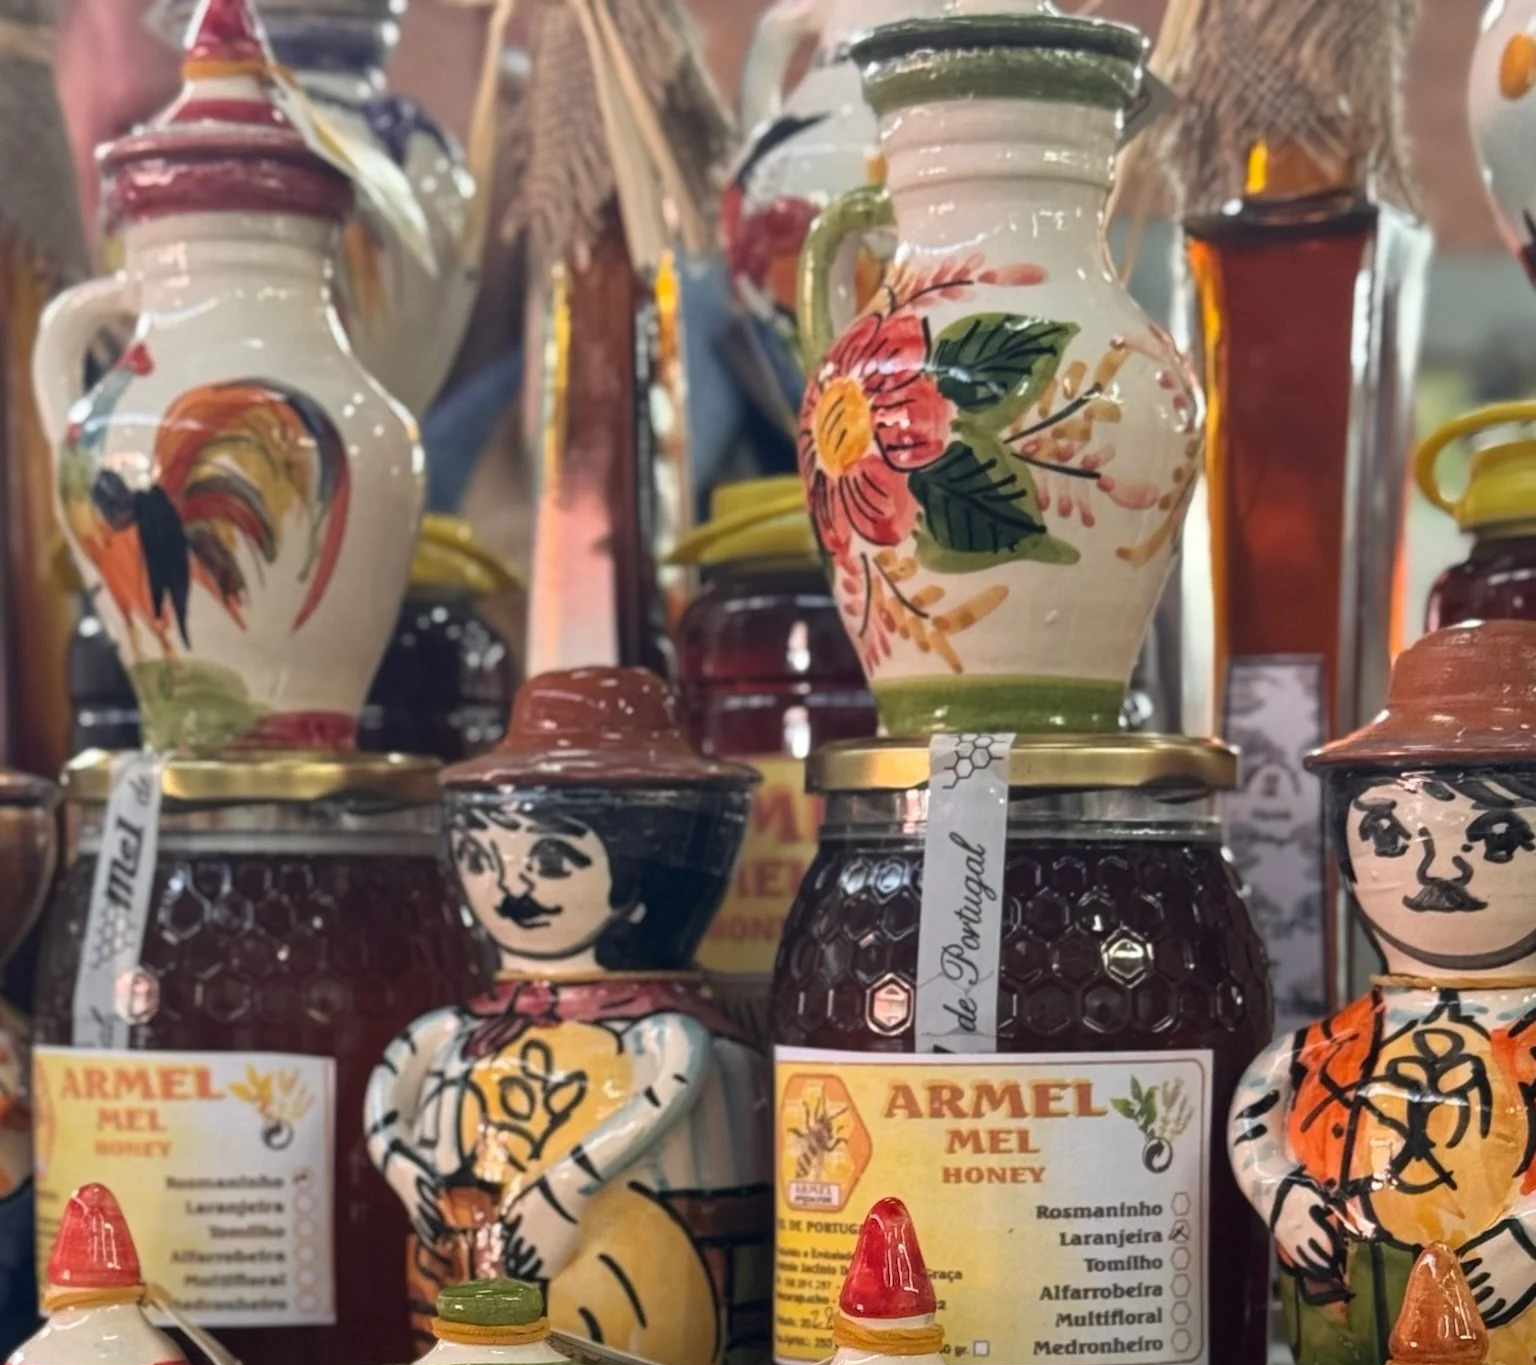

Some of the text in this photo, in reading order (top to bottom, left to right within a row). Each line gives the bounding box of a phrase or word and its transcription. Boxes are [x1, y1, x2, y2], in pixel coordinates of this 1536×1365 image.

[940, 831, 998, 1033] de Portugal
[60, 1065, 225, 1101] ARMEL
[882, 1079, 1109, 1118] ARMEL
[97, 1107, 167, 1132] MEL
[945, 1127, 1041, 1154] MEL
[942, 1166, 1047, 1184] HONEY
[1036, 1202, 1163, 1219] Rosmaninho
[806, 1222, 861, 1236] PORTUG
[1059, 1229, 1163, 1248] Laranjeira
[1084, 1255, 1163, 1272] Tomilho
[1040, 1282, 1163, 1301] Alfarrobeira
[1055, 1307, 1163, 1327] Multifloral
[1033, 1336, 1164, 1355] Medronheiro
